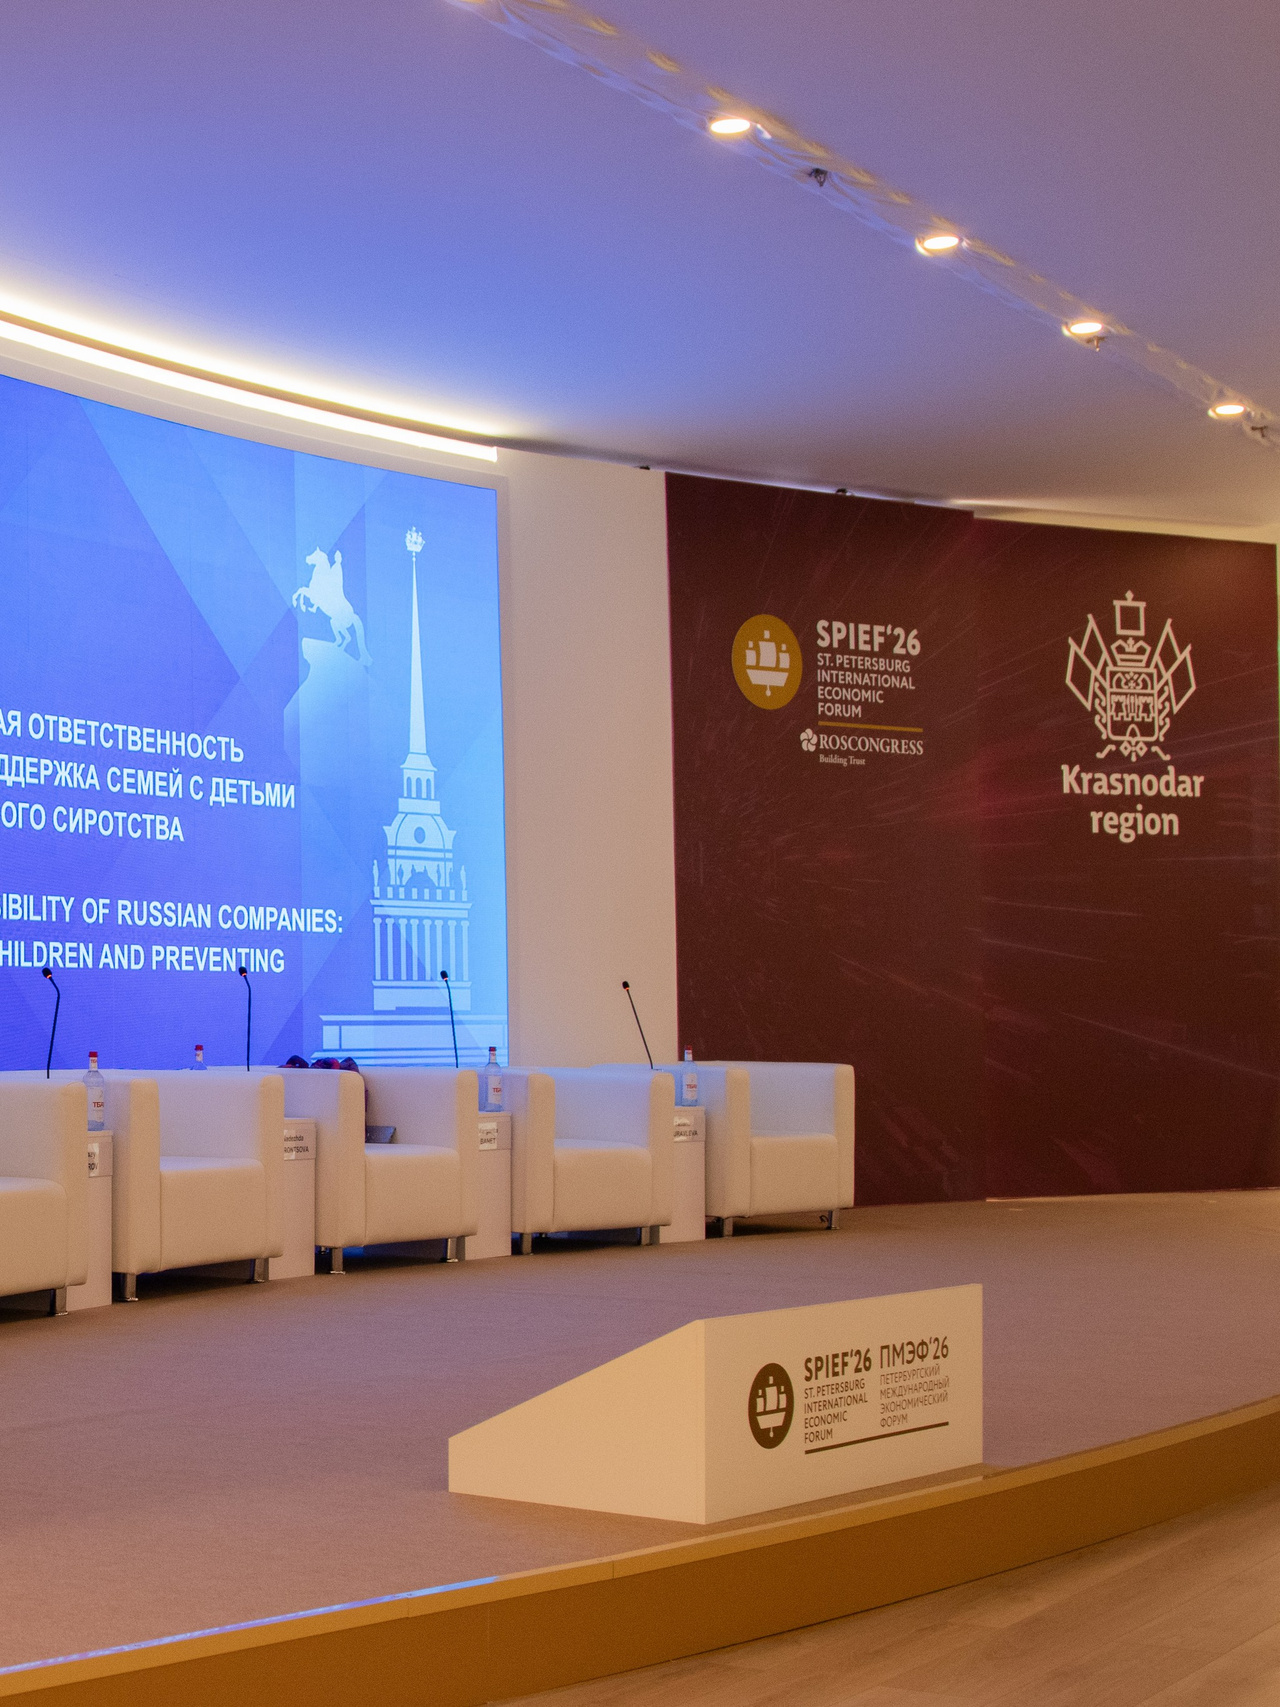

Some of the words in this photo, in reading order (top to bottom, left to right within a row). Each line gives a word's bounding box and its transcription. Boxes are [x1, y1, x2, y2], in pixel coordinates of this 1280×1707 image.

[818, 653, 833, 666] ST.
[836, 655, 910, 672] PETERSBURG
[818, 670, 915, 689] INTERNATIONAL
[818, 686, 884, 703] ECONOMIC
[818, 702, 861, 717] FORUM
[29, 713, 244, 762] ОТВЕТСТВЕННОСТЬ
[820, 734, 923, 755] ROSCONGRESS
[820, 754, 847, 766] Building
[848, 755, 866, 765] Trust
[107, 767, 182, 798] СЕМЕЙ
[190, 776, 203, 800] С
[210, 778, 294, 808] ДЕТЬМИ
[1061, 764, 1204, 797] Krasnodar
[54, 806, 184, 841] СИРОТСТВА
[1090, 804, 1178, 843] region
[82, 898, 110, 923] OF
[118, 900, 211, 928] RUSSIAN
[219, 905, 342, 932] COMPANIES:
[99, 944, 144, 969] AND
[152, 946, 284, 973] PREVENTING
[880, 1364, 940, 1384] ПЕТЕРБУРГСКИЙ
[804, 1388, 815, 1399] ST.
[817, 1378, 864, 1396] PETERSBURG
[880, 1376, 949, 1398] МЕЖДУНАРОДНЫЙ
[804, 1393, 868, 1414] INTERNATIONAL
[880, 1390, 948, 1414] ЭКОНОМИЧЕСКИЙ
[804, 1411, 847, 1428] ECONOMIC
[880, 1414, 907, 1427] ФОРУМ
[804, 1428, 833, 1443] FORUM
